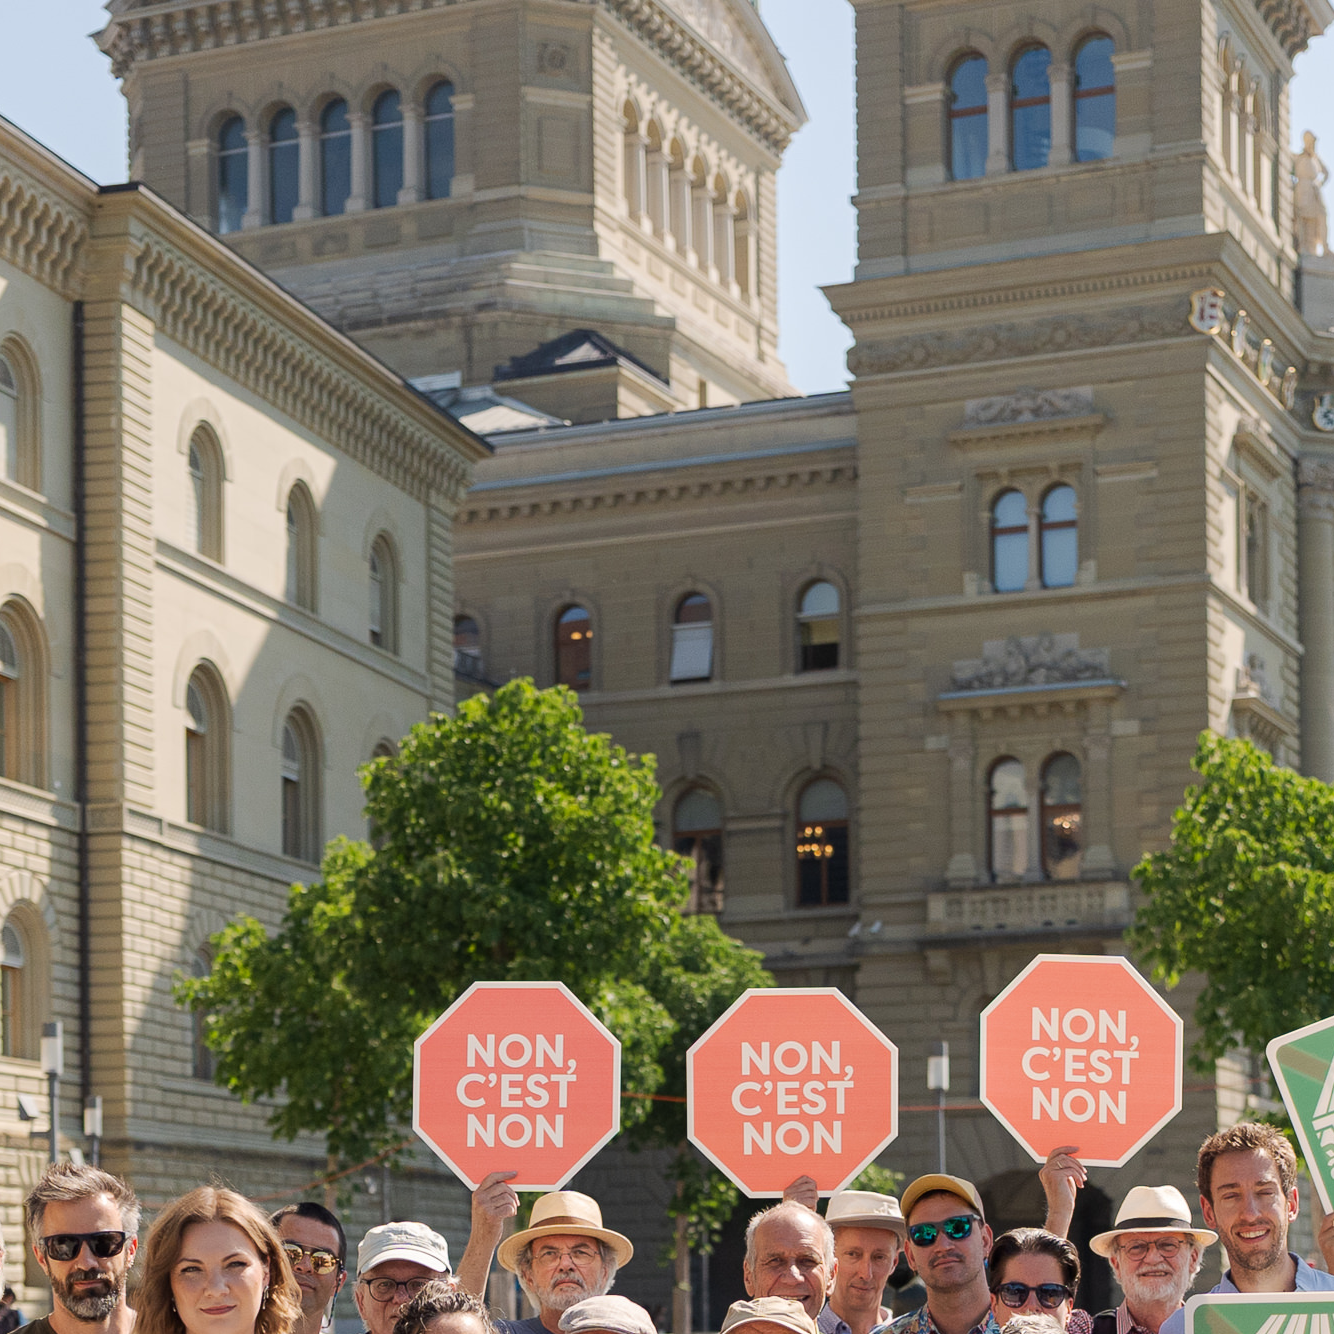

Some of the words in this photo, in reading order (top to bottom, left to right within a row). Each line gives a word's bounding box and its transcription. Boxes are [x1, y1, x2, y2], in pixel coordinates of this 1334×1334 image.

[1031, 1007, 1139, 1051] NON,
[467, 1033, 577, 1075] NON,
[741, 1041, 855, 1080] NON,
[1022, 1047, 1140, 1085] C’EST
[456, 1074, 577, 1108] C’EST
[732, 1080, 854, 1116] C’EST
[1032, 1087, 1127, 1125] NON
[467, 1114, 564, 1148] NON
[743, 1121, 842, 1155] NON
